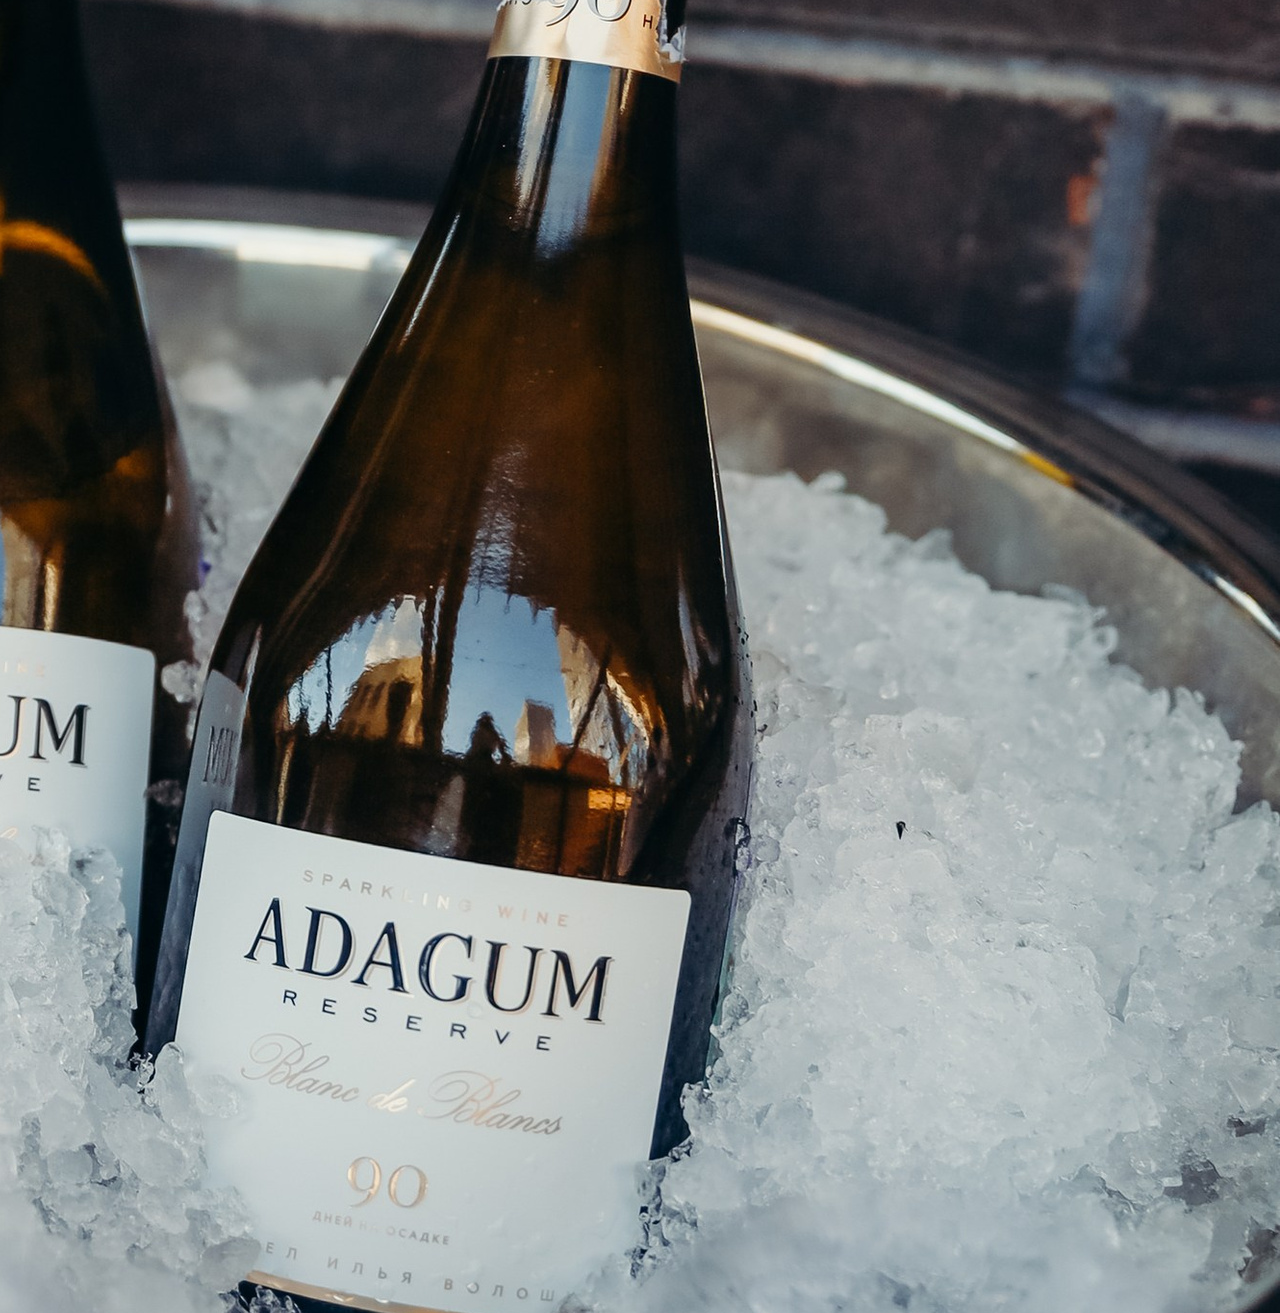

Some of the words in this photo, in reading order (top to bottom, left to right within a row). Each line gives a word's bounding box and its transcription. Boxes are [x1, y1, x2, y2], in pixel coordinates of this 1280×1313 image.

[302, 869, 472, 912] SPARKLING
[498, 904, 570, 927] WINE
[243, 897, 616, 1025] ADAGUM
[282, 989, 552, 1052] RESERVE
[240, 1032, 360, 1103] Blanc
[367, 1078, 416, 1113] de
[417, 1070, 564, 1135] Blancs
[347, 1156, 429, 1209] 90
[312, 1209, 353, 1228] ДНЕЙ
[385, 1225, 451, 1246] ОСАДКЕ
[326, 1256, 412, 1284] ИЛЬЯ
[443, 1278, 556, 1302] ВОЛОШ
